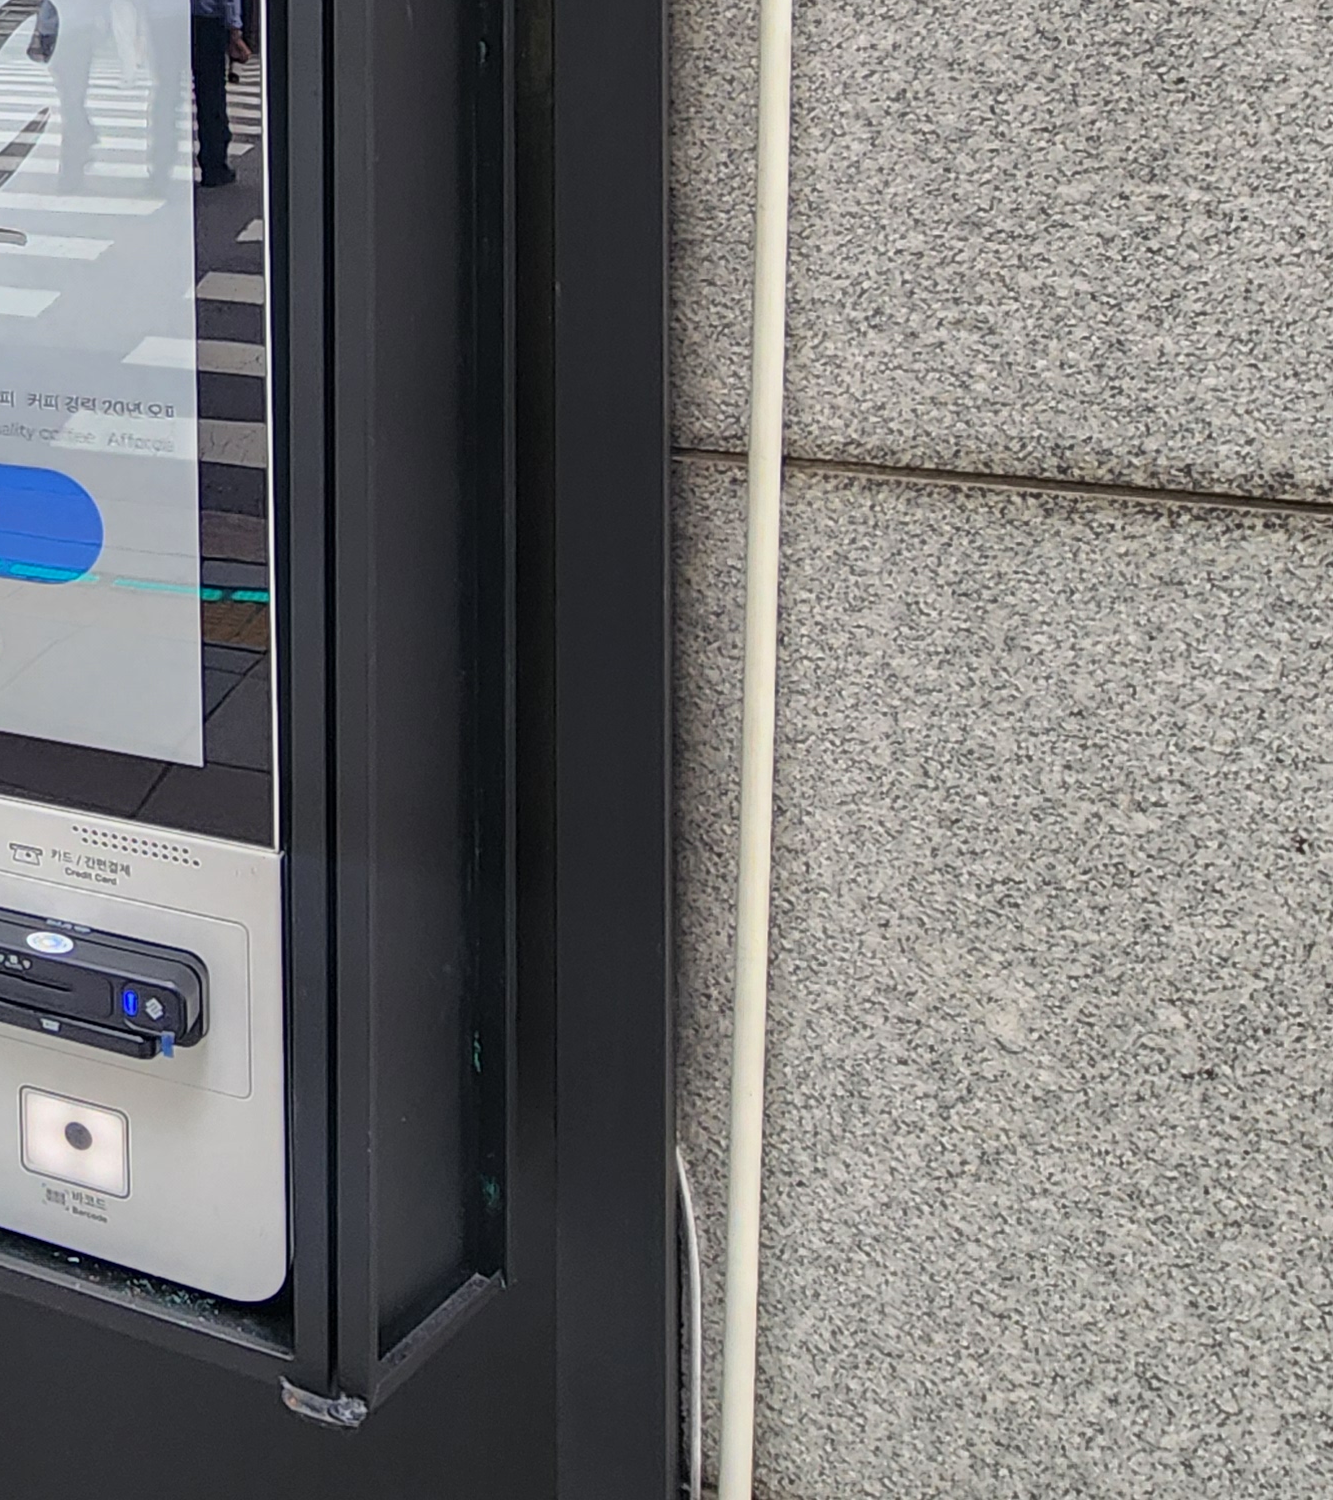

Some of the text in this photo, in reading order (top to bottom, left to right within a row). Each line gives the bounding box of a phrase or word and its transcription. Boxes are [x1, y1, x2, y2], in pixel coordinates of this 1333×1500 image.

[27, 392, 60, 411] 커피
[64, 396, 97, 414] 경력
[101, 399, 143, 419] 20년
[51, 848, 73, 863] 카드
[84, 856, 131, 878] 간편결제
[65, 866, 118, 886] Credit Card
[72, 1191, 107, 1211] 바코드
[71, 1205, 108, 1223] Barcode
